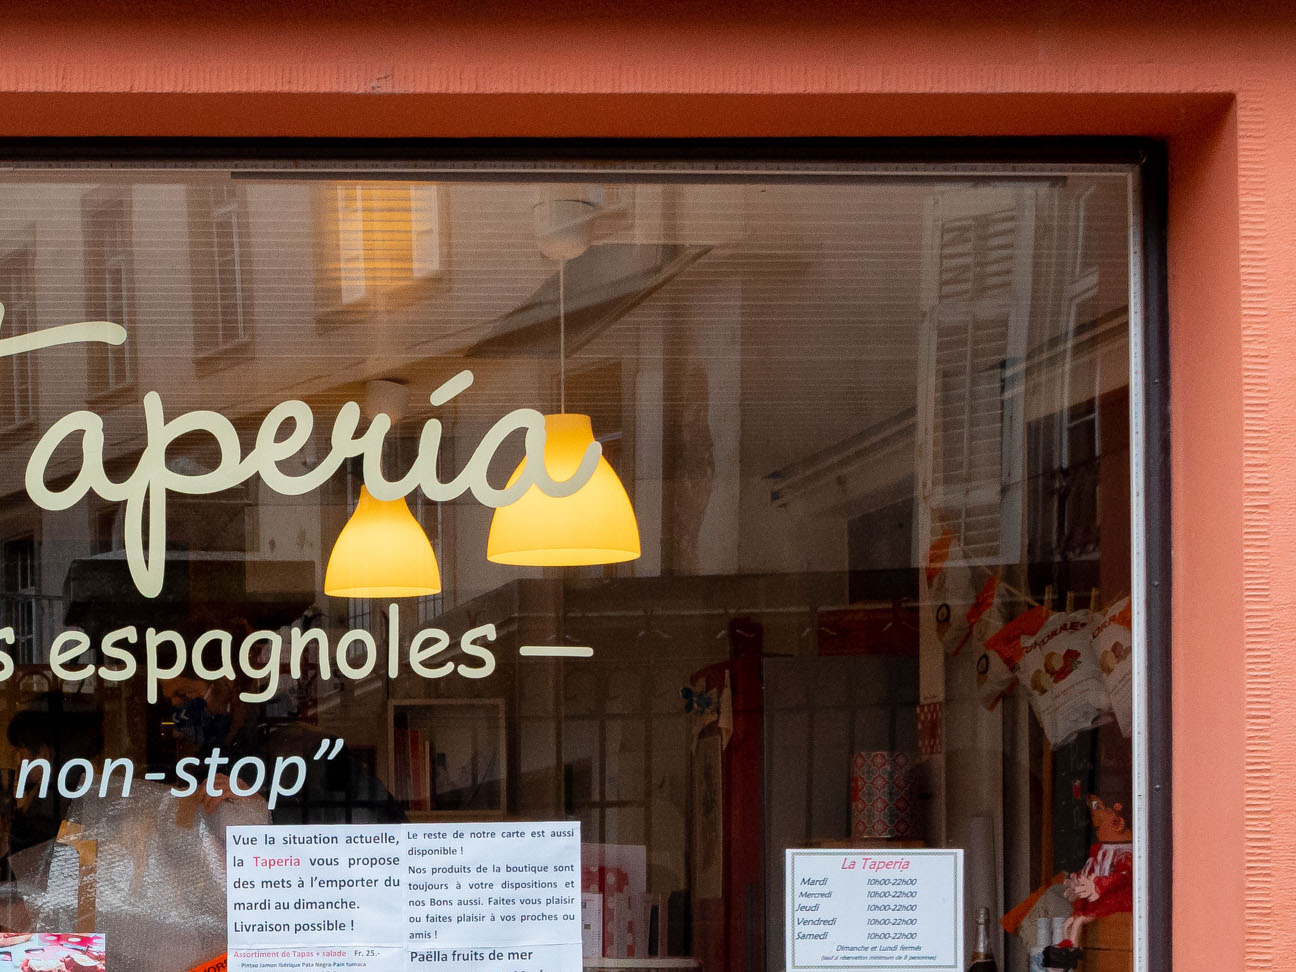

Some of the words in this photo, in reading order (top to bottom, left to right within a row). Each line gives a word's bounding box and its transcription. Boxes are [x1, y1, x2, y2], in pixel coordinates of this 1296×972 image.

[49, 603, 498, 704] espagnoles
[232, 834, 258, 846] Vue
[264, 833, 276, 846] la
[282, 833, 339, 845] situation
[345, 831, 400, 846] actuelle,
[407, 831, 418, 840] Le
[423, 831, 448, 840] reste
[452, 829, 465, 840] de
[469, 830, 497, 839] notre
[500, 829, 526, 839] carte
[530, 829, 546, 838] est
[550, 828, 575, 838] aussi
[407, 846, 458, 858] disponible
[233, 855, 244, 868] la
[252, 855, 301, 870] Taperia
[308, 857, 340, 867] vous
[348, 856, 400, 869] propose
[840, 857, 857, 873] La
[861, 857, 911, 873] Taperia
[408, 865, 427, 875] Nos
[431, 864, 472, 876] produits
[475, 863, 489, 874] de
[492, 863, 501, 873] la
[505, 863, 549, 875] boutique
[553, 863, 575, 873] sont
[233, 877, 256, 889] des
[261, 878, 293, 889] mets
[297, 876, 305, 889] à
[384, 875, 400, 888] du
[799, 876, 829, 886] Mardi
[866, 878, 918, 886] 10h00-22h00
[798, 890, 833, 899] Mercredi
[866, 890, 918, 899] 10h00-22h00
[233, 898, 271, 911] mardi
[274, 901, 290, 911] au
[293, 897, 360, 911] dimanche.
[408, 899, 426, 907] nos
[429, 897, 454, 907] Bons
[456, 897, 484, 907] aussi.
[487, 896, 516, 906] Faites
[519, 897, 542, 905] vous
[545, 895, 576, 907] plaisir
[795, 902, 821, 912] Jeudi
[866, 903, 918, 912] 10h00-22h00
[234, 920, 290, 933] Livraison
[294, 919, 347, 935] possible
[796, 916, 838, 926] Vendredi
[866, 918, 918, 926] 10h00-22h00
[795, 931, 830, 941] Samedi
[866, 932, 918, 940] 10h00-22h00
[233, 950, 280, 960] Assortiment
[281, 950, 291, 959] de
[292, 950, 314, 959] Tapas
[322, 949, 347, 958] salade
[354, 949, 365, 957] Fr.
[410, 950, 448, 963] Paëlla
[451, 949, 485, 962] fruits
[488, 948, 504, 961] de
[507, 951, 534, 961] mer
